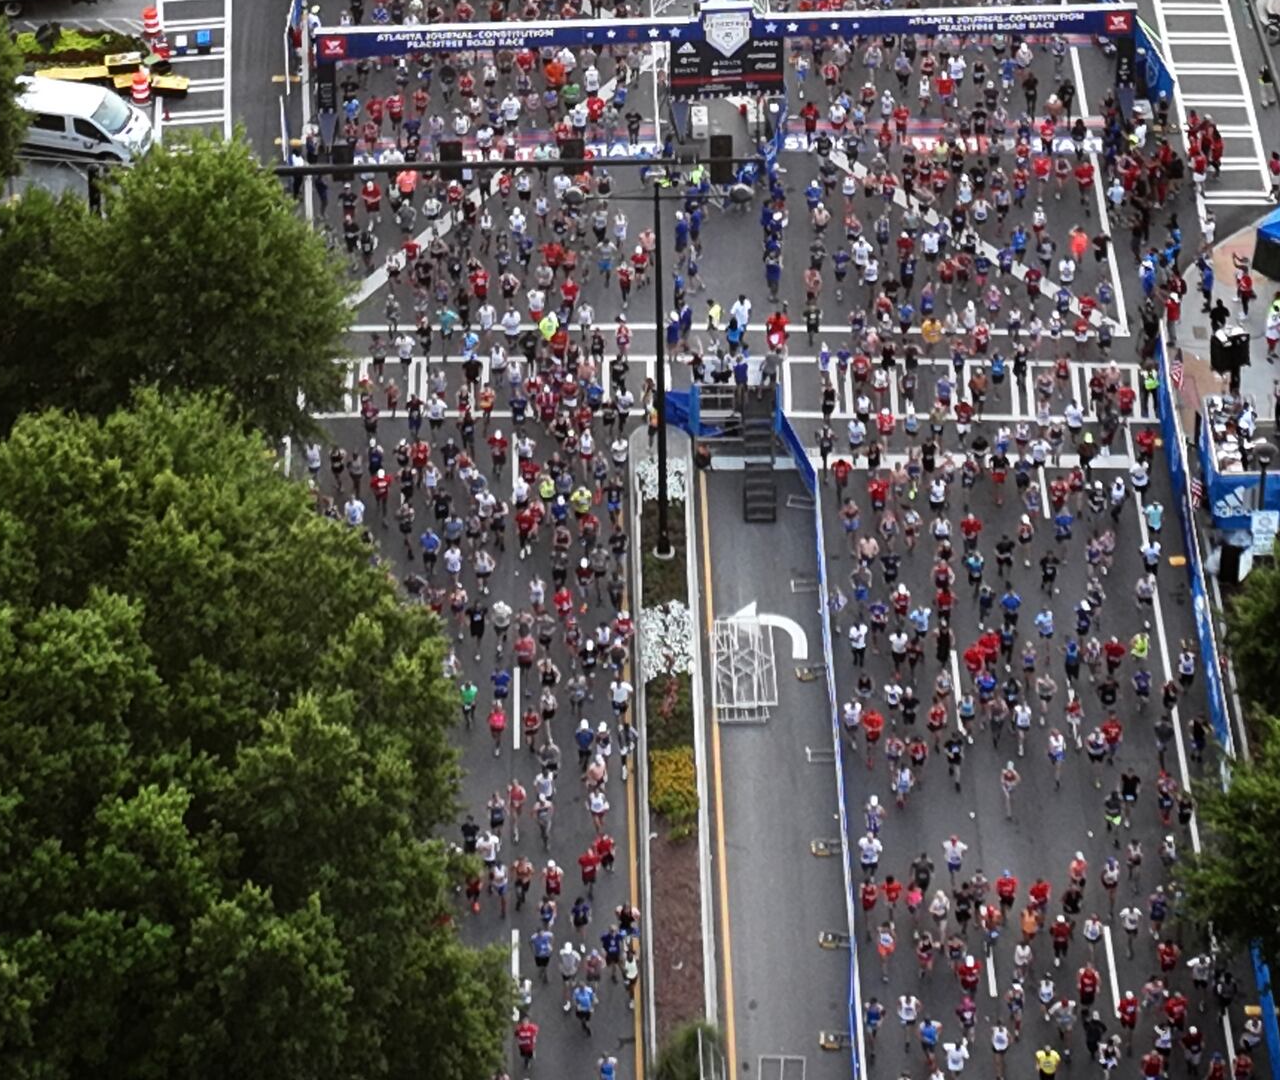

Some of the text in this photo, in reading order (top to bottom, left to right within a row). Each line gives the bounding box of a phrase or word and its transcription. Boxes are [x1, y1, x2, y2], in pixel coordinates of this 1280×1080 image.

[997, 21, 1026, 31] ROAD
[1029, 20, 1055, 30] RACE
[466, 38, 496, 48] ROAD
[498, 37, 525, 47] RACE
[1213, 505, 1252, 518] adida
